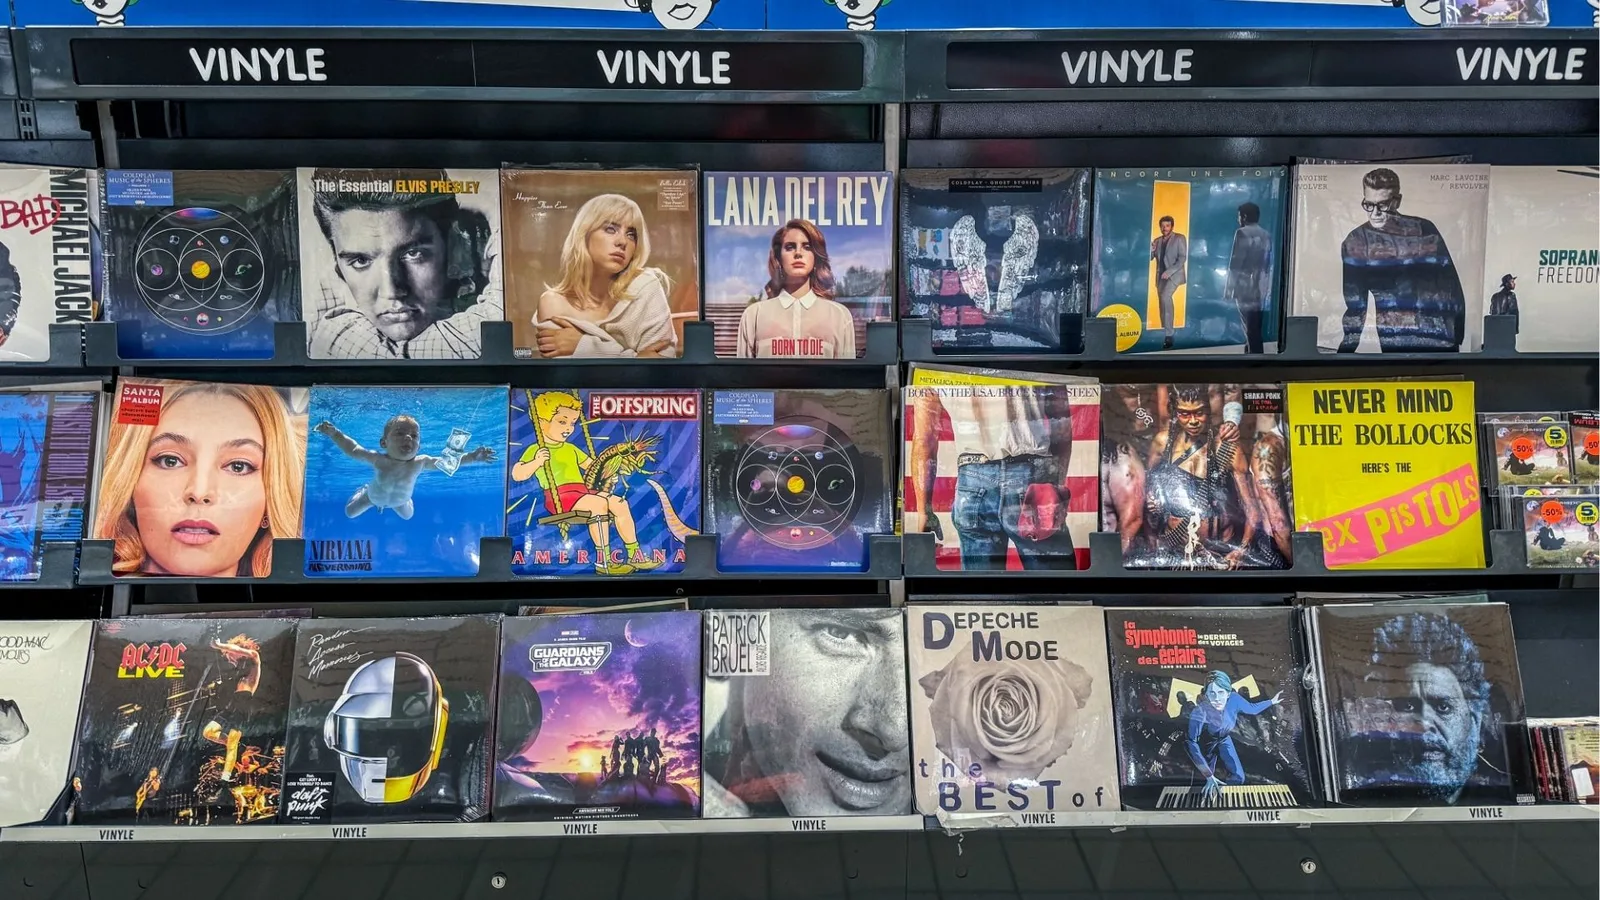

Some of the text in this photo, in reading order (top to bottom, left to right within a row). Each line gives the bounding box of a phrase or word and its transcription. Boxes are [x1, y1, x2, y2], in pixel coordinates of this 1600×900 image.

[189, 47, 327, 82] VINYLE
[597, 49, 731, 84] VINYLE
[1061, 48, 1194, 85] VINYLE
[1456, 47, 1587, 80] VINYLE
[315, 179, 480, 195] The Essential ELVIS PRESLEY
[708, 176, 888, 226] LANA DEL REY
[0, 194, 61, 235] BAD
[51, 169, 91, 265] MICHAEL
[1539, 249, 1599, 266] SOPRAN
[772, 339, 824, 356] BORN TO DIE
[123, 387, 161, 397] SANTA
[950, 388, 971, 397] THE
[132, 397, 160, 405] ALBUM
[601, 396, 697, 415] OFFSPRING
[1313, 388, 1453, 414] NEVER MIND
[1294, 423, 1473, 446] THE BOLLOCKS
[1513, 445, 1534, 453] -50%
[47, 452, 90, 481] YOUR
[1361, 462, 1412, 474] HERE'S THE
[1542, 508, 1563, 517] -50%
[309, 540, 372, 560] NIRVANA
[511, 549, 686, 565] AMERICANA
[308, 562, 372, 572] NEVERMIND
[923, 612, 1039, 650] DEPECHE
[1124, 621, 1136, 629] la
[307, 627, 377, 656] Random
[1124, 626, 1198, 648] symphonie
[534, 646, 605, 658] GUARDIANS
[972, 630, 1059, 662] MODE
[550, 656, 601, 667] GALAXY
[712, 643, 753, 674] BRUEL
[1137, 645, 1207, 665] des éclairs
[118, 665, 185, 678] LIVE
[919, 758, 983, 778] the
[291, 786, 330, 802] daft
[938, 780, 1104, 812] BEST of
[286, 796, 329, 816] punk
[1469, 807, 1503, 817] VINYLE
[1021, 814, 1056, 824] VINYLE
[1246, 811, 1281, 821] VINYLE
[332, 828, 367, 838] VINYLE
[563, 824, 598, 834] VINYLE
[792, 820, 827, 831] VINYLE
[99, 830, 134, 840] VINYLE
